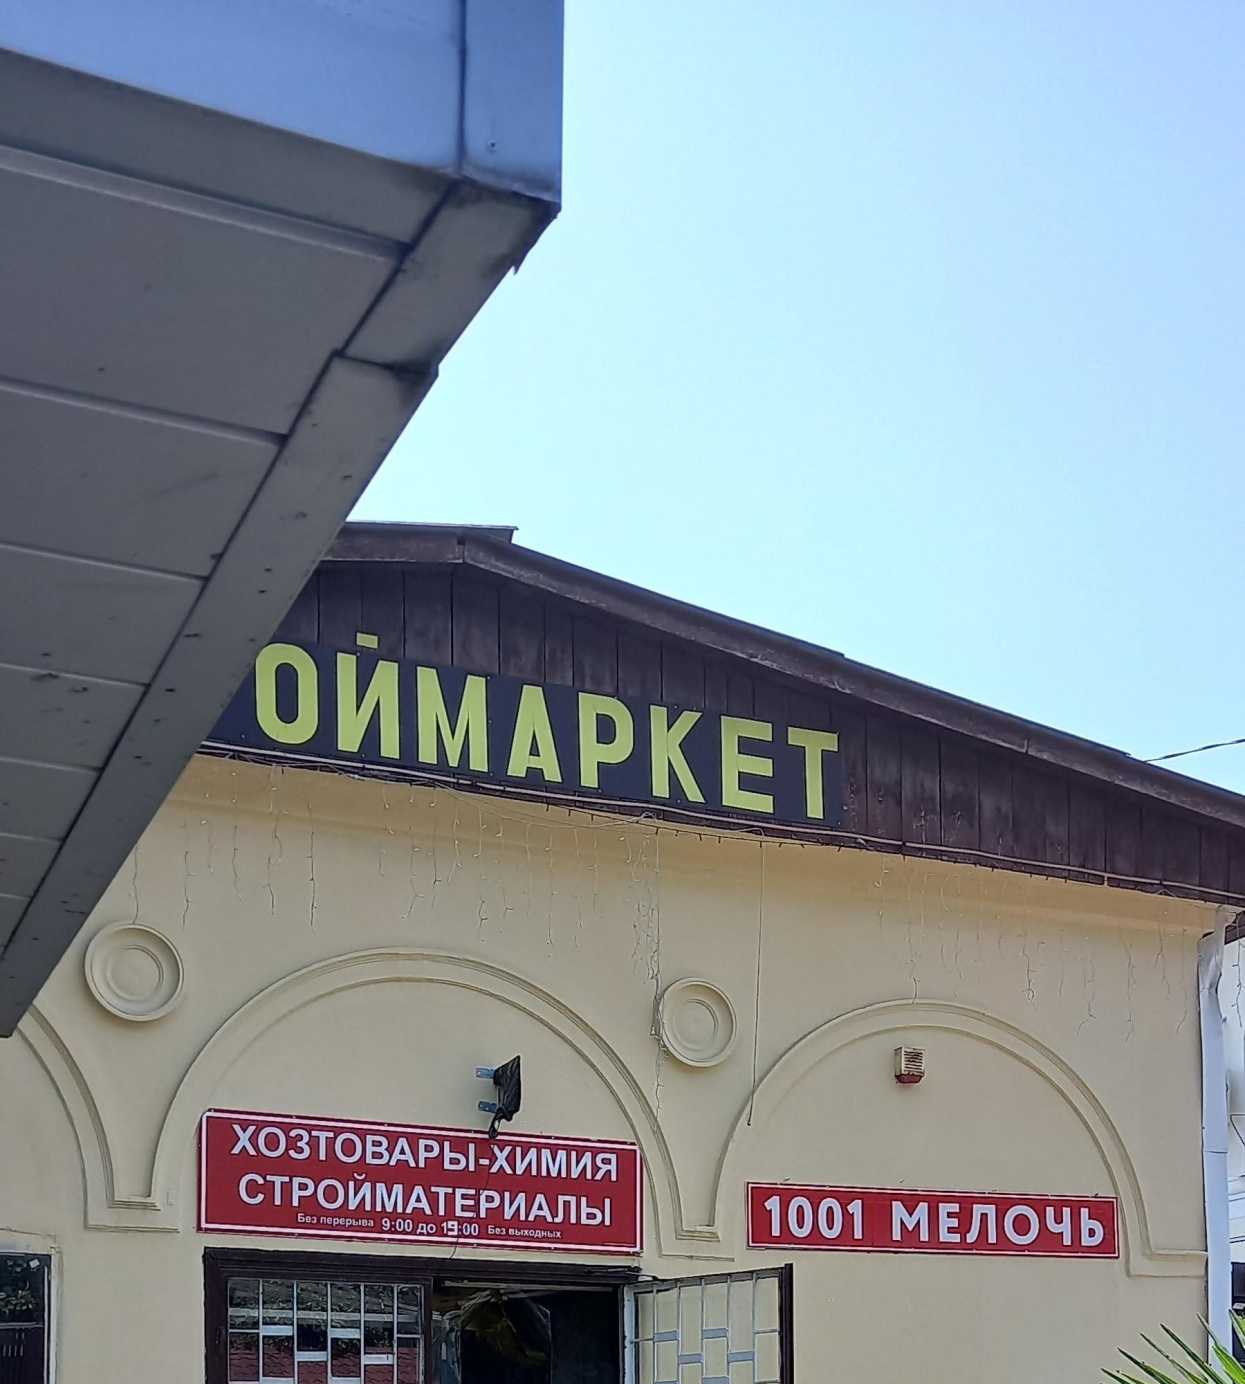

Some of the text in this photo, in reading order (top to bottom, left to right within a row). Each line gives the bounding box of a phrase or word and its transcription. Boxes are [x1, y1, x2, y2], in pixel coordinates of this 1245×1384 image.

[254, 632, 839, 820] ОЙМАРКЕТ
[230, 1123, 618, 1182] ХОЗТОВАРЫ-ХИМИЯ
[238, 1172, 611, 1227] СТРОЙМАТЕРИАЛЫ
[297, 1212, 562, 1239] Без перерыва 9:00 до 19:00 Без выходных
[764, 1196, 1106, 1247] 1001 МЕЛОЧЬ
